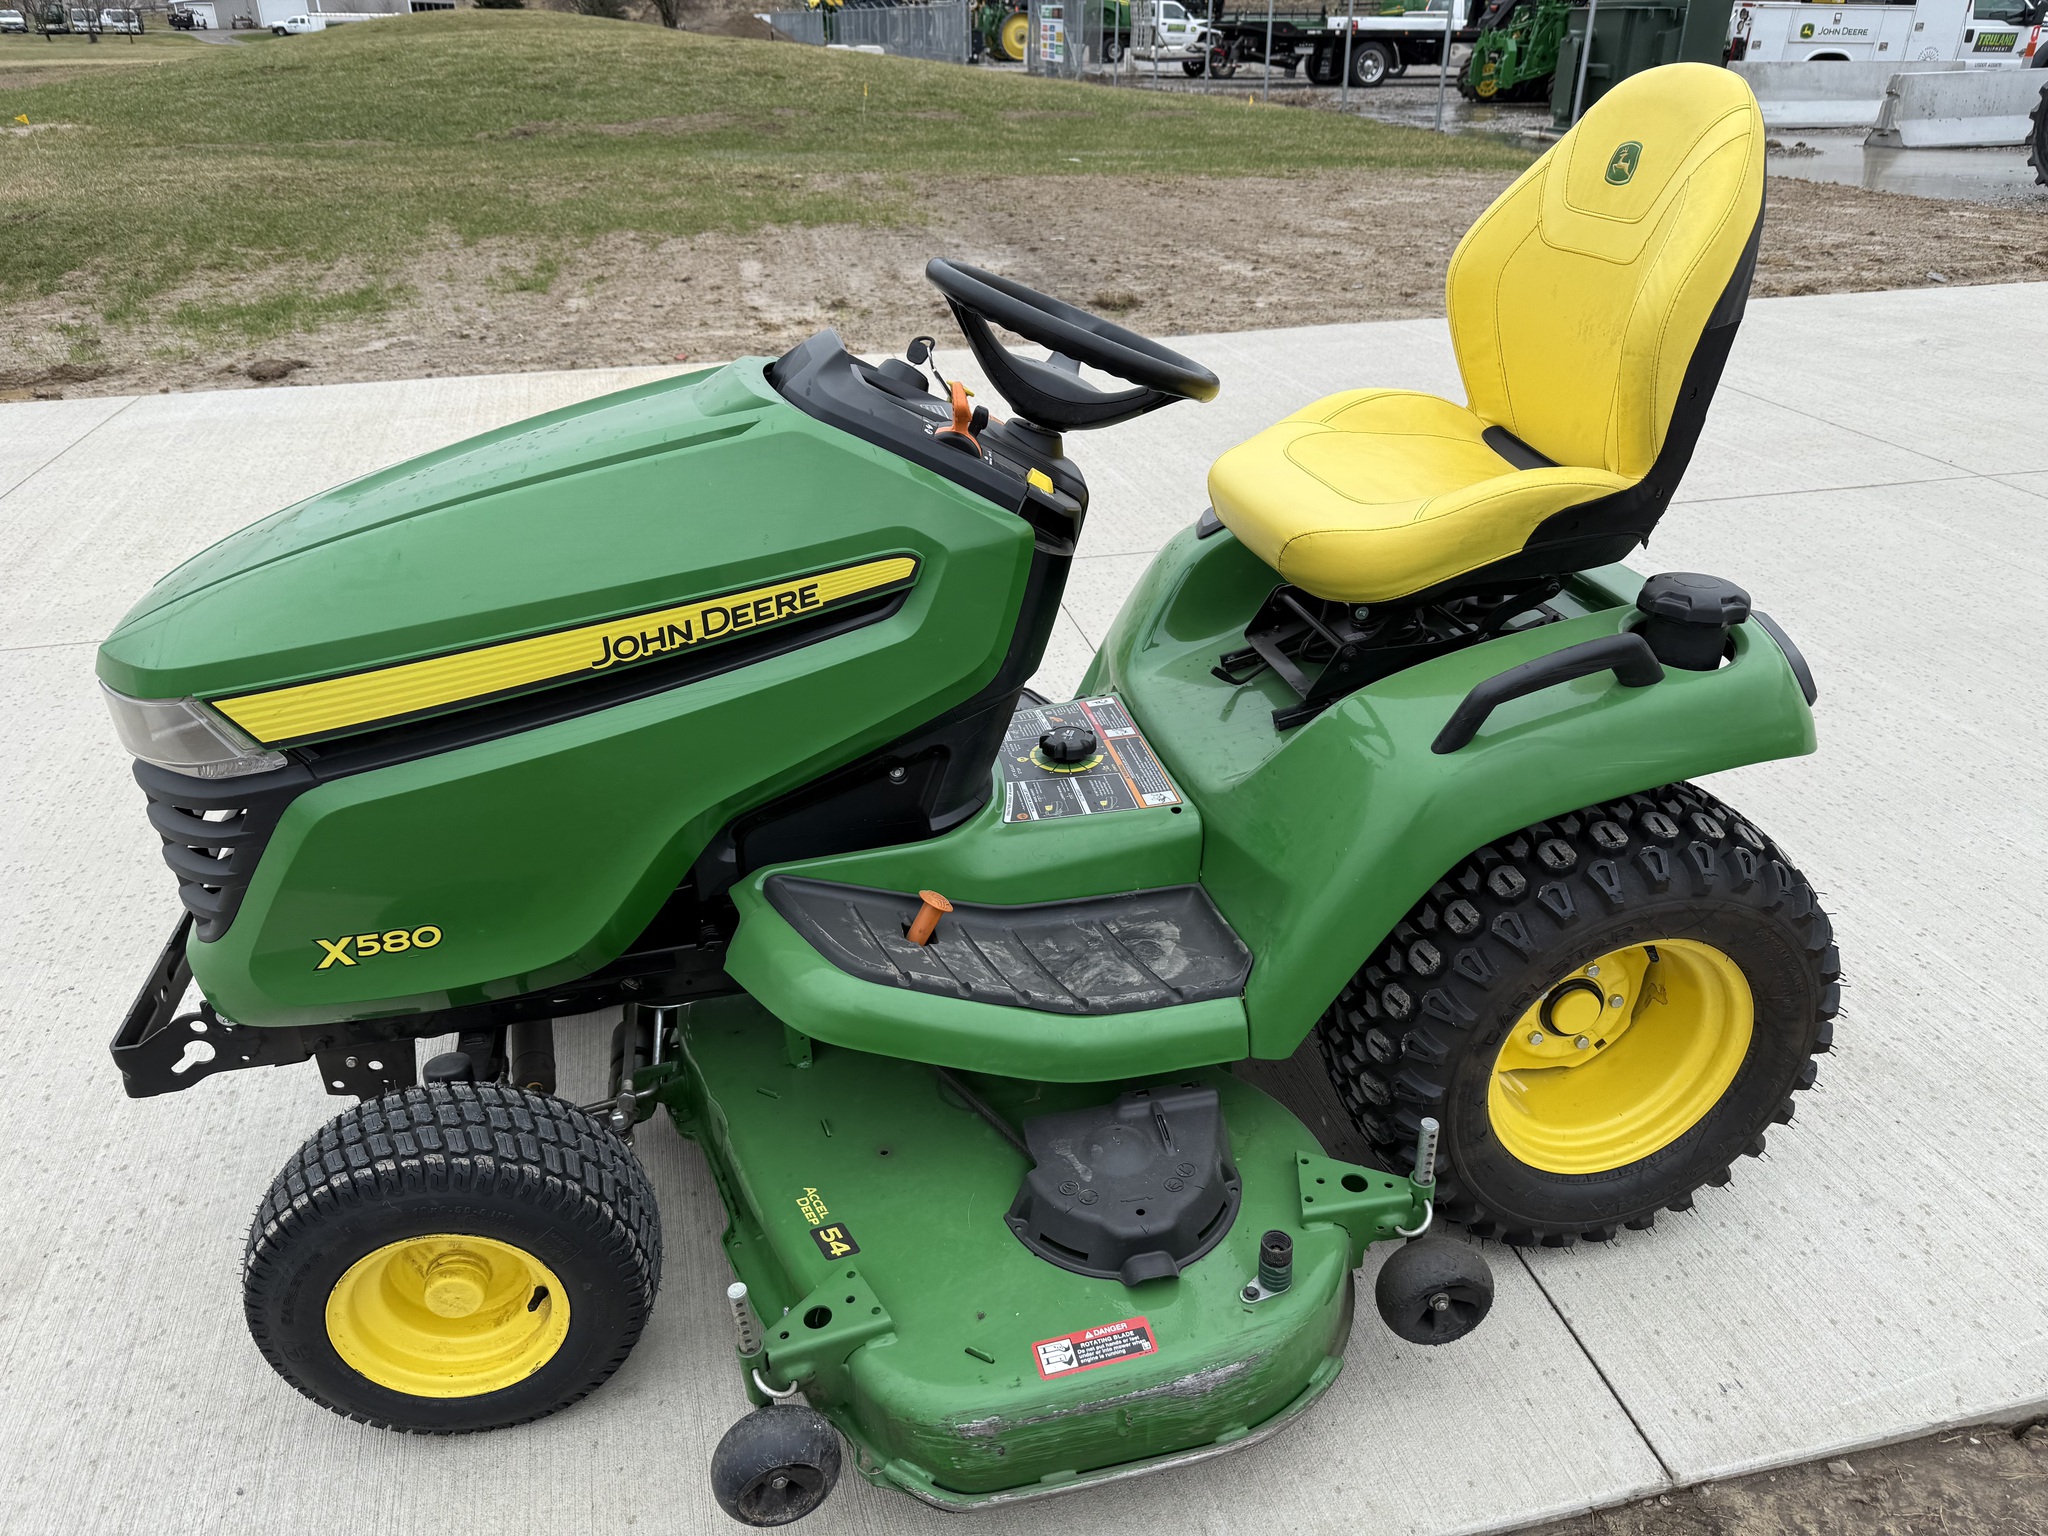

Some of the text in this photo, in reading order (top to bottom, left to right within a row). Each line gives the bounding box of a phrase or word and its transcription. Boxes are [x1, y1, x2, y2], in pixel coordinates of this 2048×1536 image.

[1818, 26, 1869, 36] JOHN DEERE
[1978, 34, 2016, 46] TRULAND
[591, 582, 821, 668] JOHN DEERE
[313, 925, 442, 970] X580
[796, 1196, 821, 1226] DEEP
[803, 1187, 830, 1220] ACCEL
[819, 1226, 852, 1257] 54
[1093, 1322, 1128, 1337] DANGER
[1080, 1330, 1135, 1349] ROTATING BLADE
[1096, 1343, 1106, 1351] put
[1105, 1340, 1122, 1349] hands
[1078, 1352, 1095, 1360] under
[1080, 1355, 1099, 1364] engine
